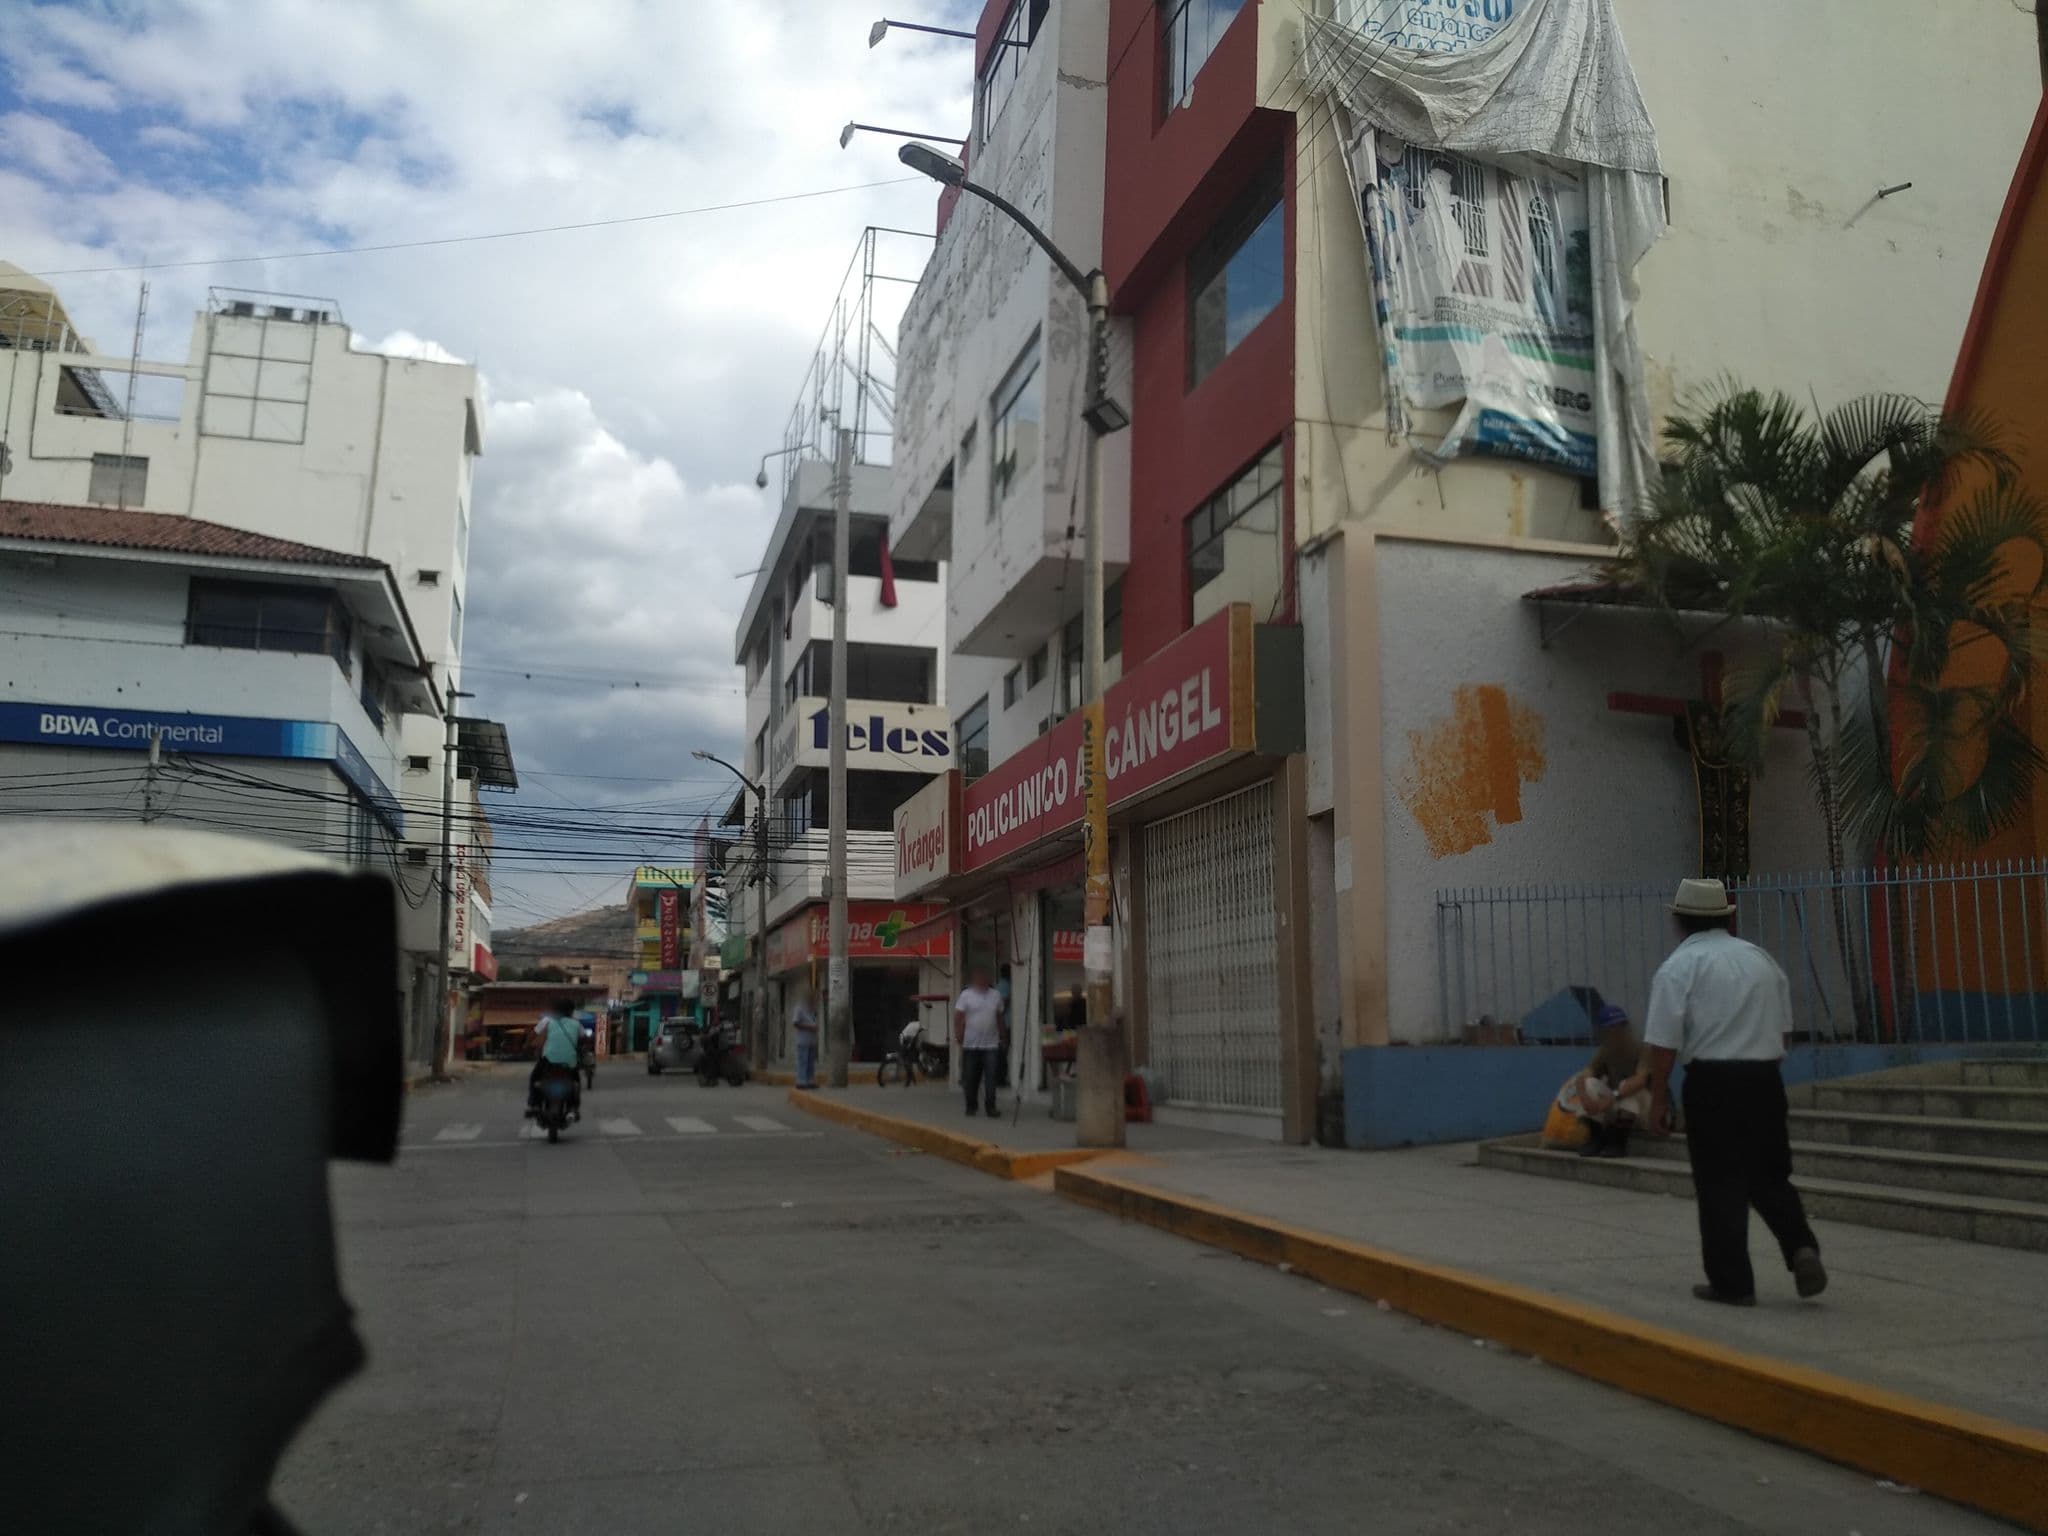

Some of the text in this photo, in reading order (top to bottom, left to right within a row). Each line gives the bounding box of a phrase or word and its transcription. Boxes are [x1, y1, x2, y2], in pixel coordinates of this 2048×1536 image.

[40, 713, 223, 744] BBVA Continental
[967, 757, 1068, 851] POLICLINICO
[1073, 667, 1221, 799] ACÁNGEL
[898, 810, 945, 878] Arcángel
